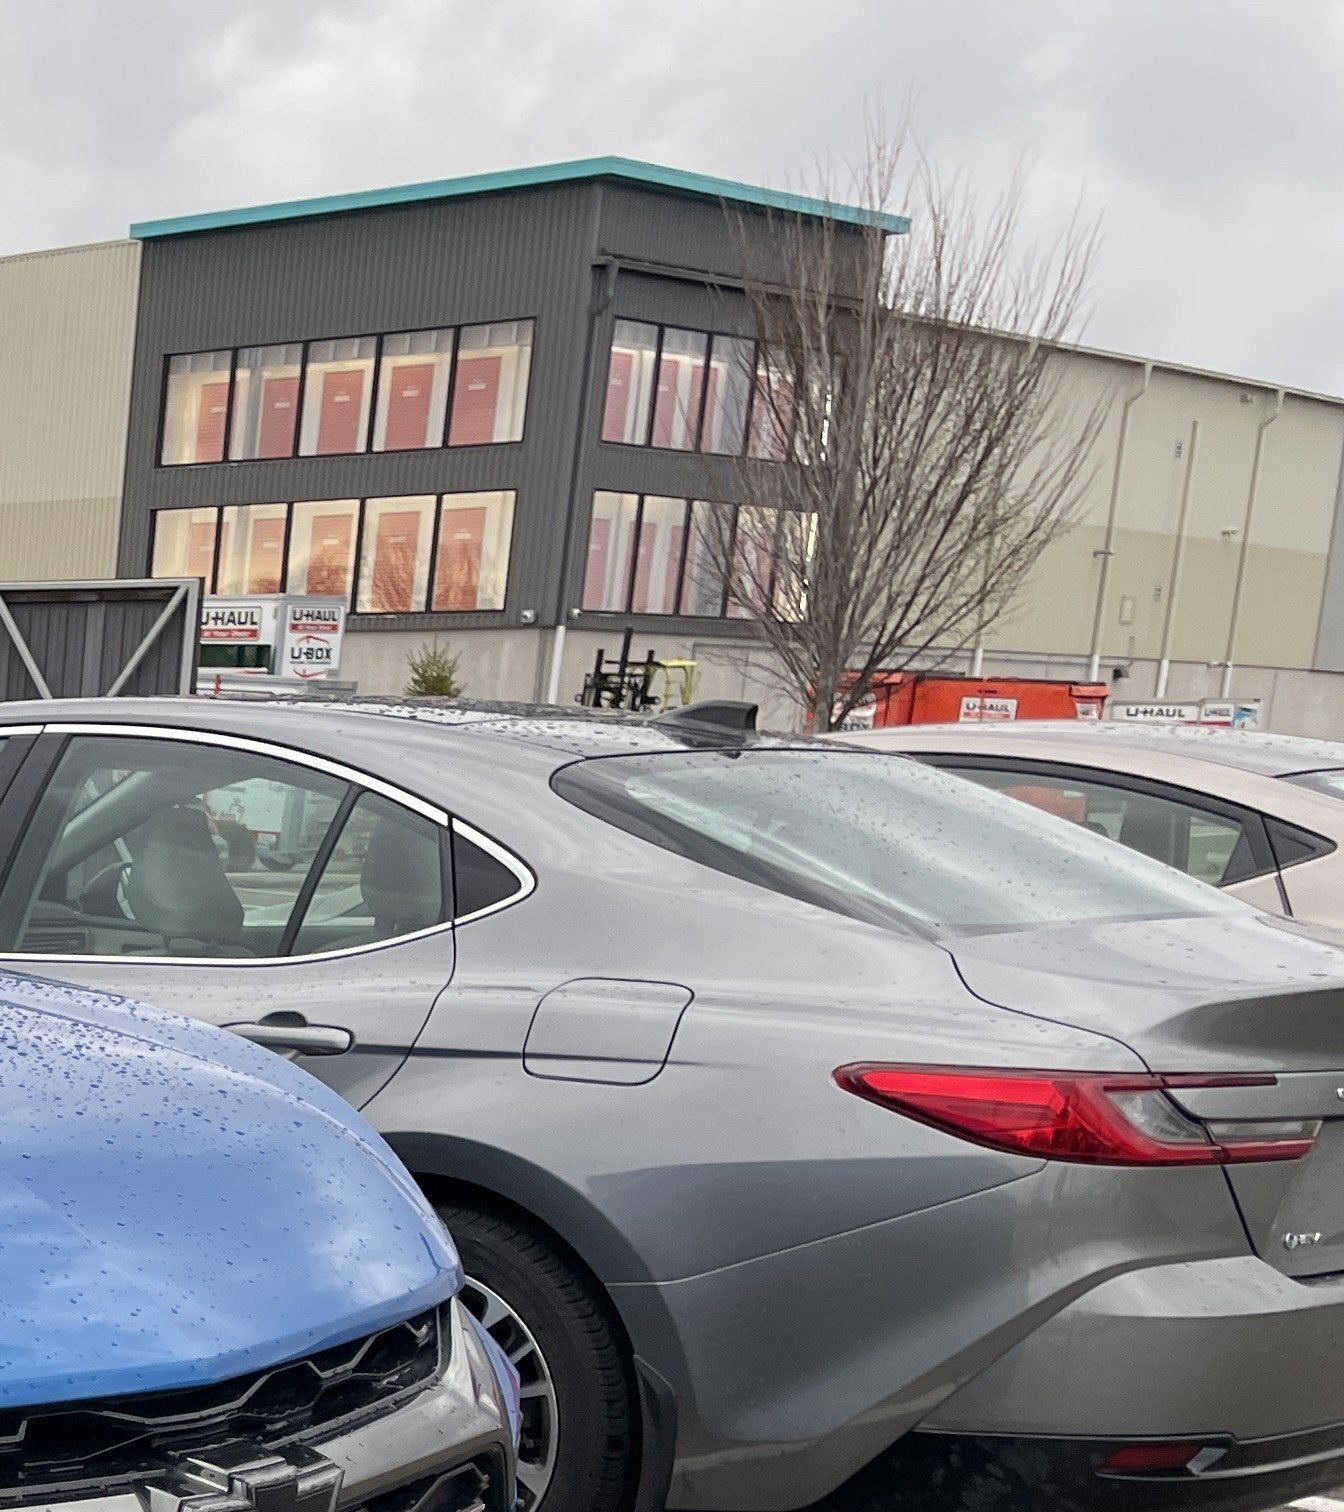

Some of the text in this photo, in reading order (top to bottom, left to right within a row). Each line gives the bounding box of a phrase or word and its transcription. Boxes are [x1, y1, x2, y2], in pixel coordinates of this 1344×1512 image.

[202, 610, 258, 626] U-HAUL
[293, 609, 338, 622] U-HAUL
[291, 647, 332, 660] U-BOX
[1126, 708, 1185, 717] U-HAUL
